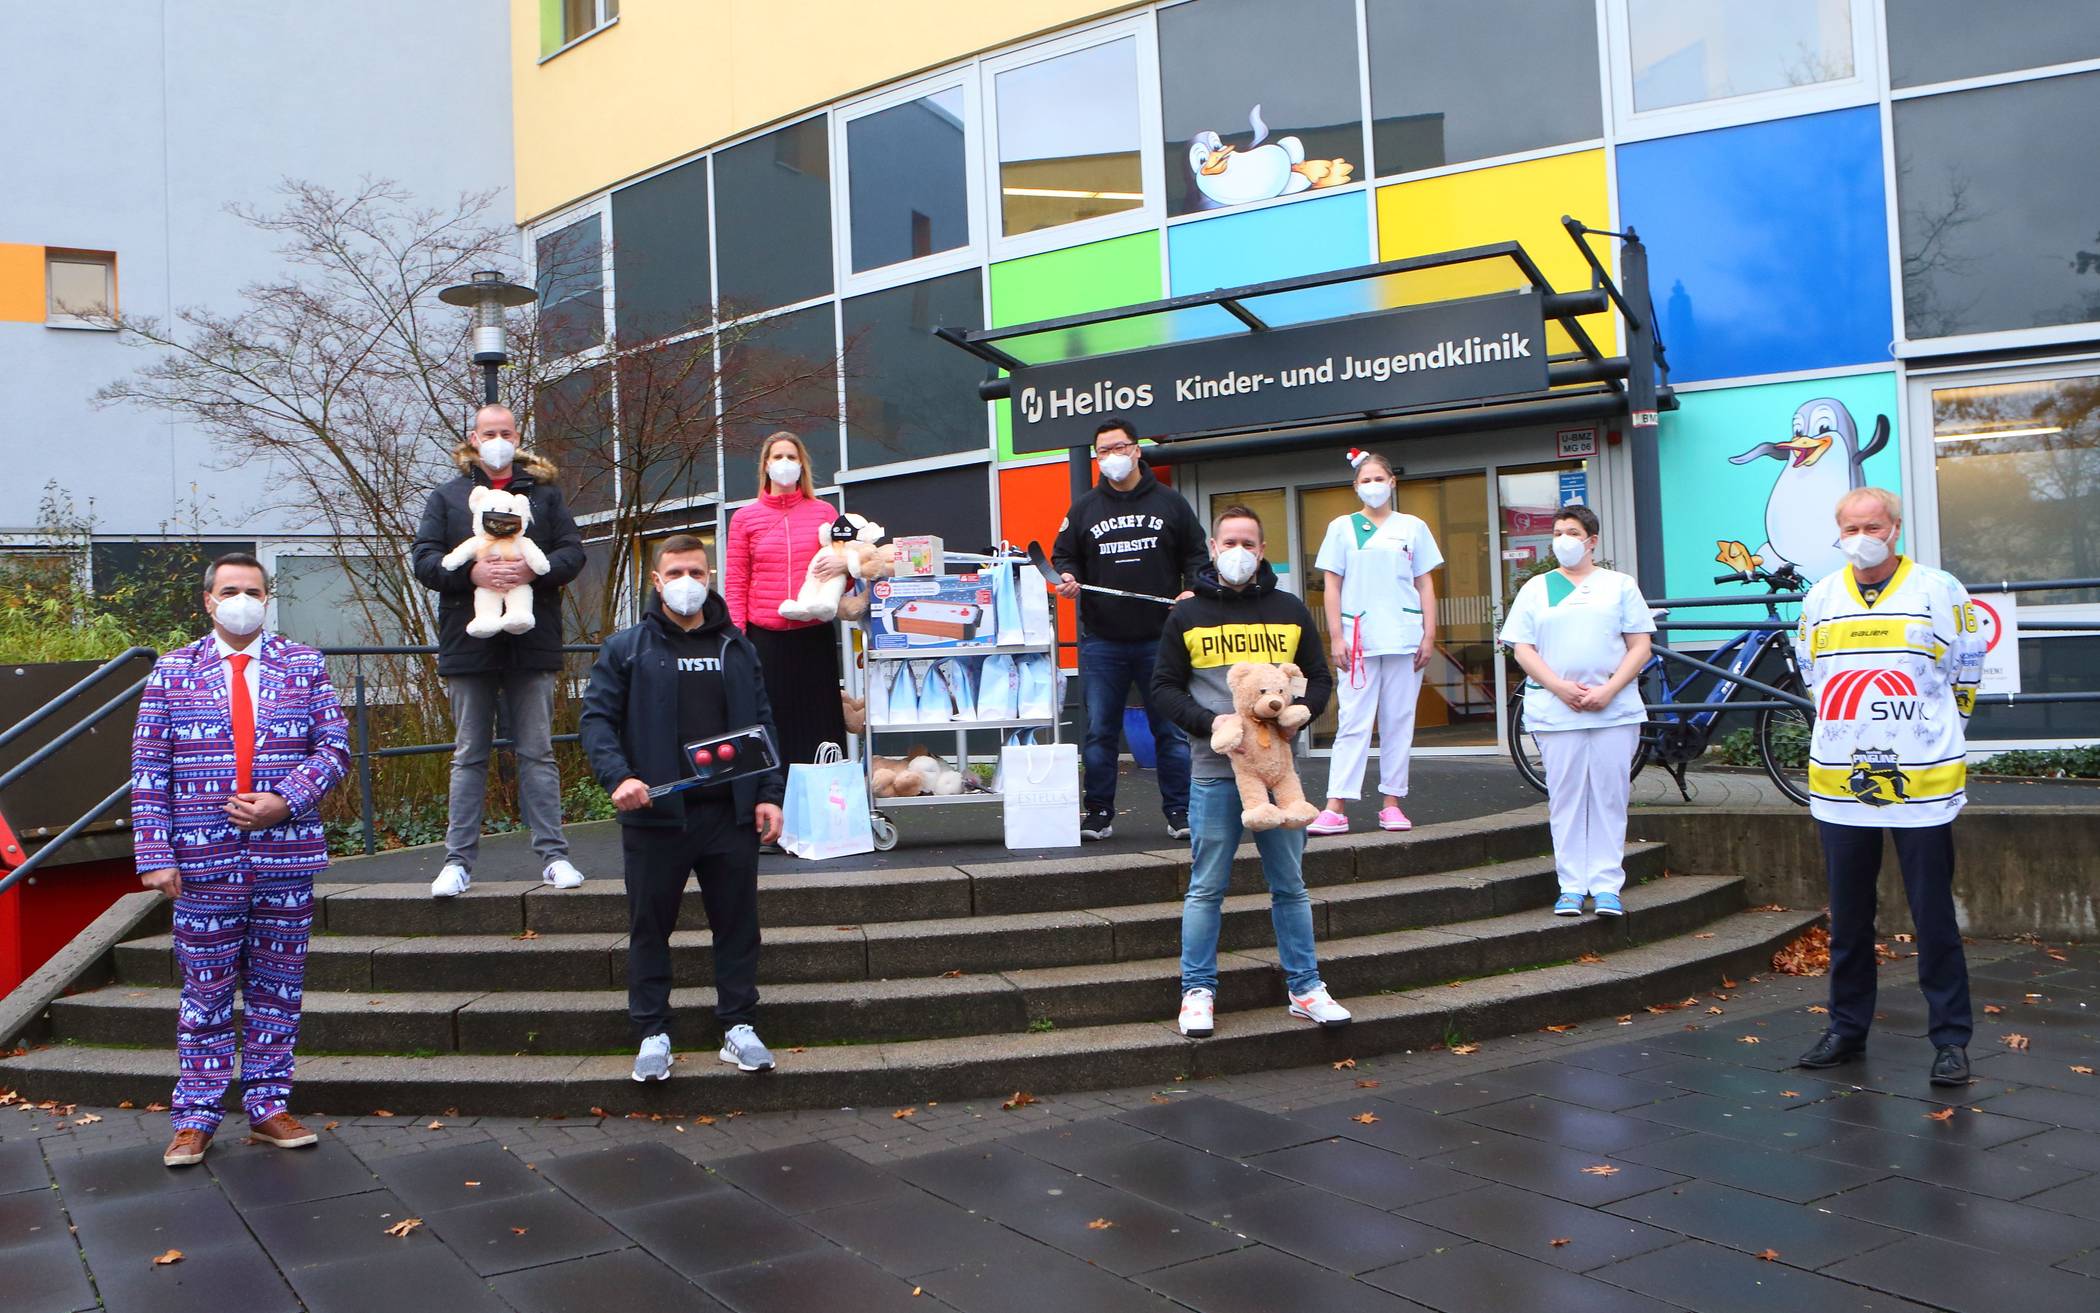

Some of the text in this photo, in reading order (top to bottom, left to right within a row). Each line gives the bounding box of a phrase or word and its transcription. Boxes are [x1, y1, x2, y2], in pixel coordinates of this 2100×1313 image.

[1049, 331, 1532, 419] Helios Kinder- und Jugendklinik
[1561, 432, 1592, 443] U-BMZ
[1563, 444, 1579, 452] MG
[1090, 514, 1164, 539] HOCKEY IS
[1098, 536, 1158, 554] DIVERSITY
[1201, 633, 1288, 656] PINGUINE
[1870, 701, 1931, 721] SWK
[1017, 791, 1068, 803] ESTELLA
